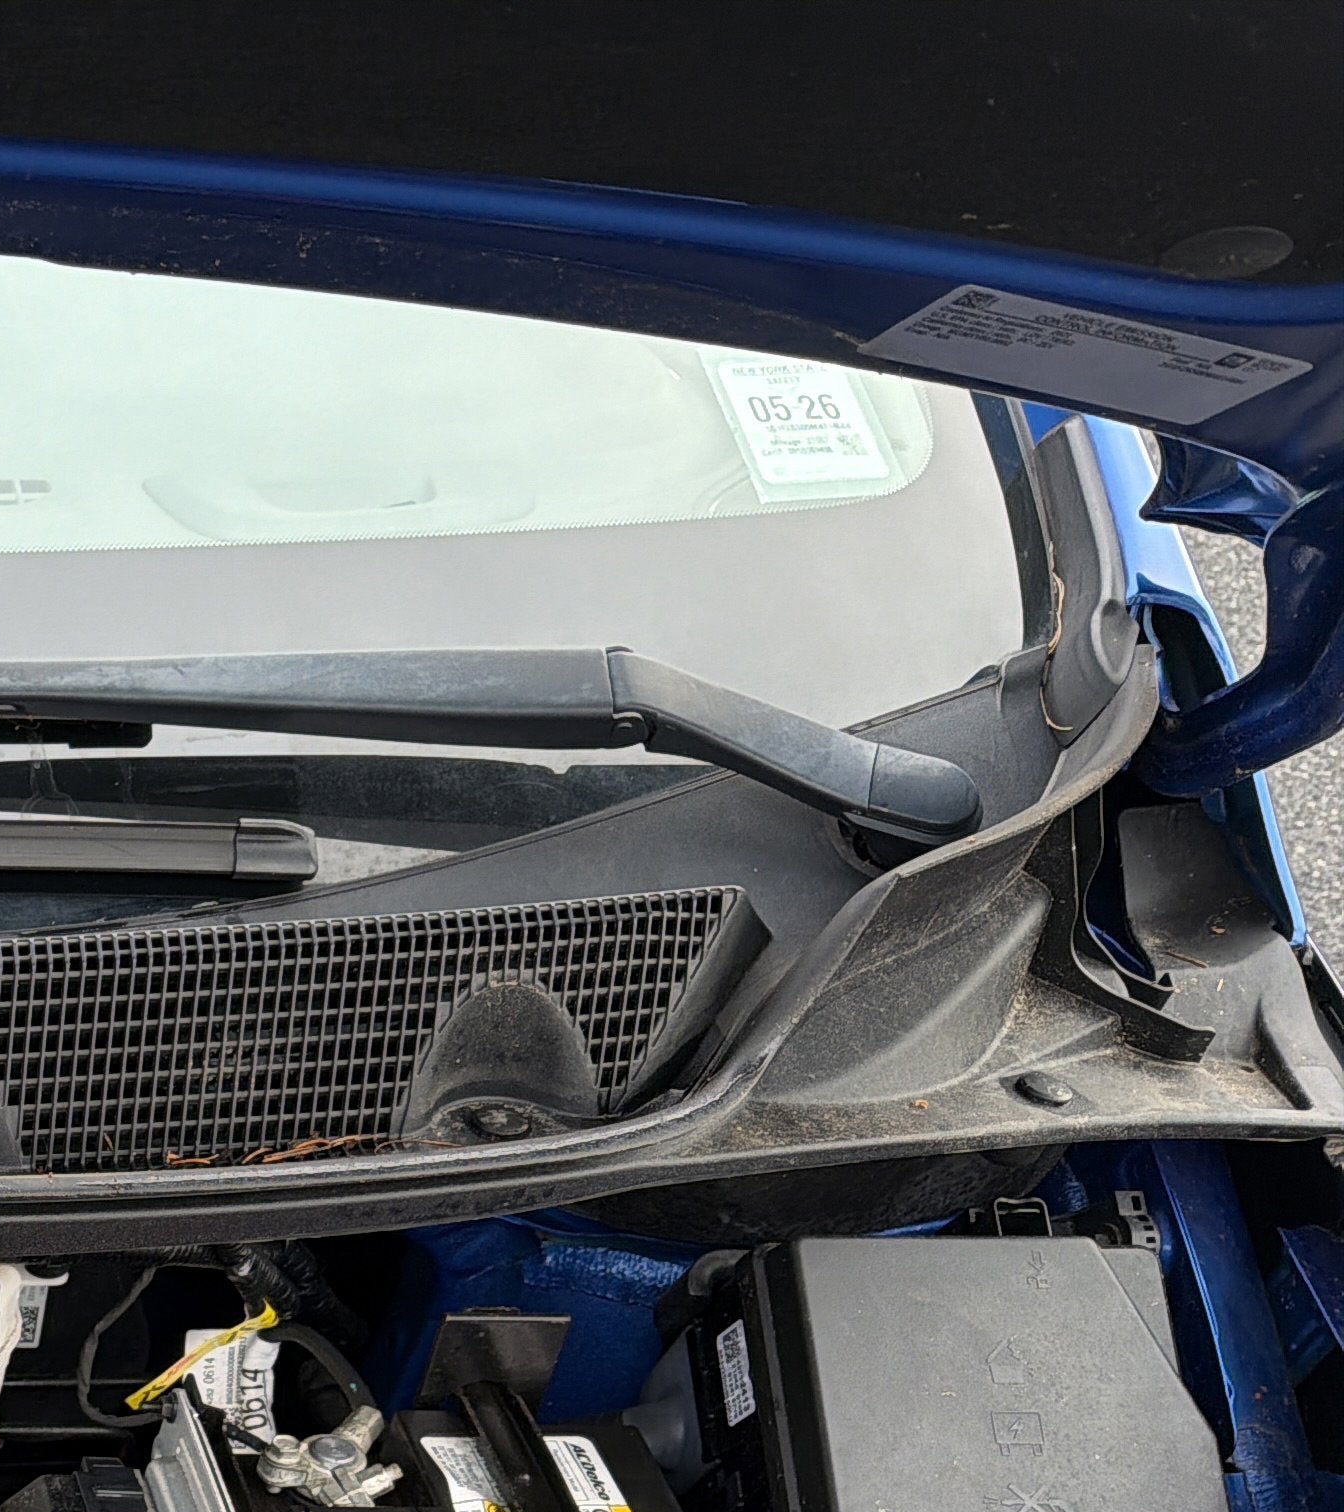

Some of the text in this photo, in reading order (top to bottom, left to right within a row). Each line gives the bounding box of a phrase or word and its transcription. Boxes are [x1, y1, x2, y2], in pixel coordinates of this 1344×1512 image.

[203, 1358, 215, 1384] 0614
[241, 1369, 267, 1430] 0614
[569, 1441, 611, 1502] ACDelco
